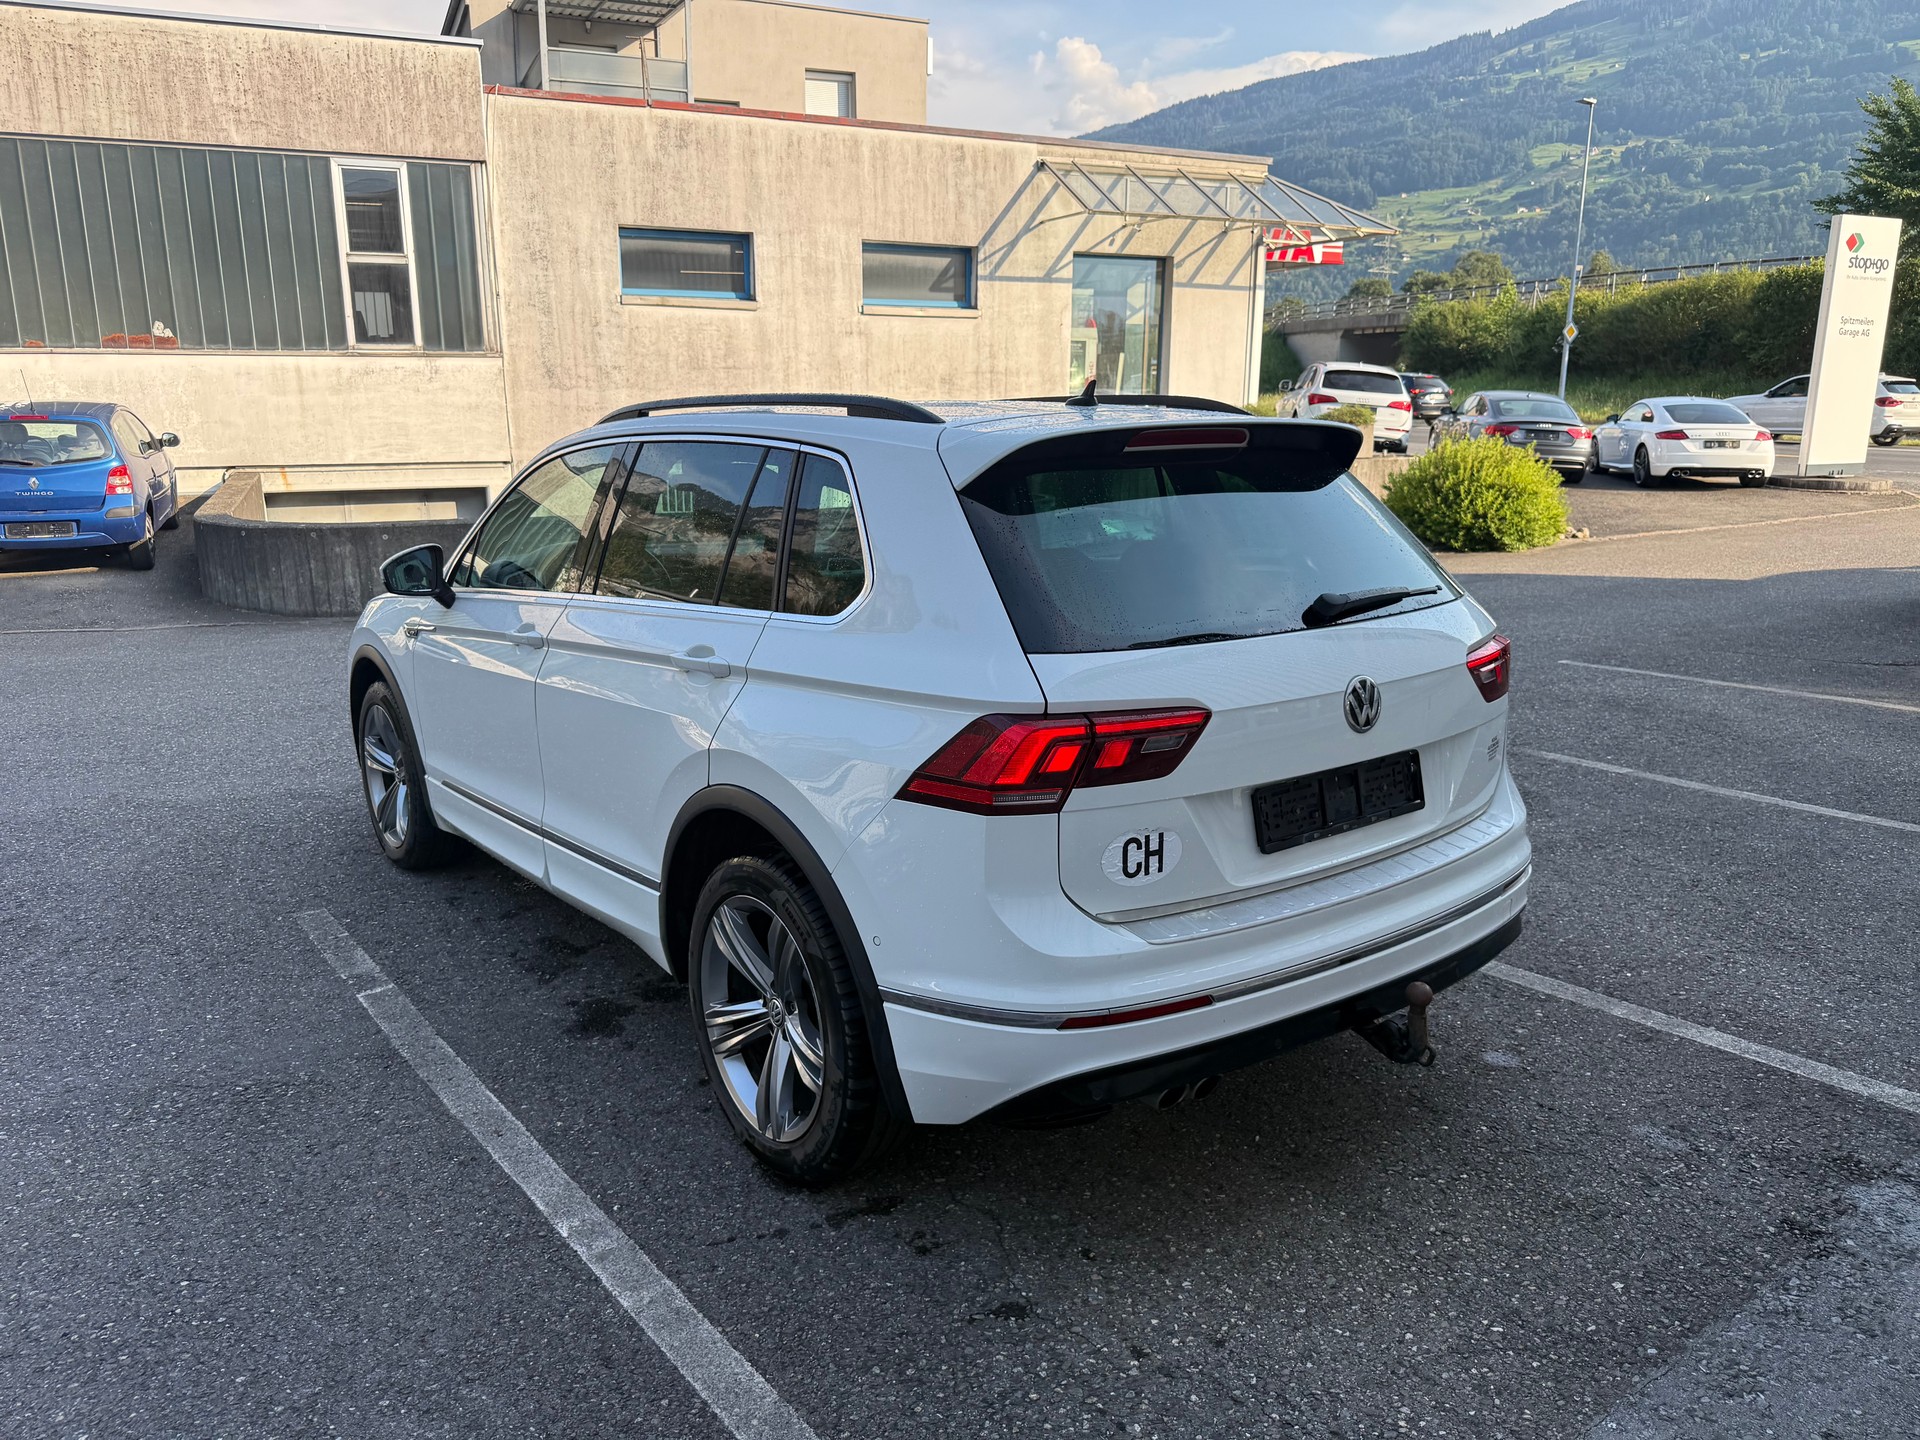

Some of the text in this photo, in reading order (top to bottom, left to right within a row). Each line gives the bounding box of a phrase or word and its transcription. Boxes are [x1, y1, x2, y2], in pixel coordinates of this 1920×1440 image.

[1848, 254, 1889, 274] stop+go
[1839, 327, 1871, 338] Garage AG
[1122, 832, 1165, 879] CH
